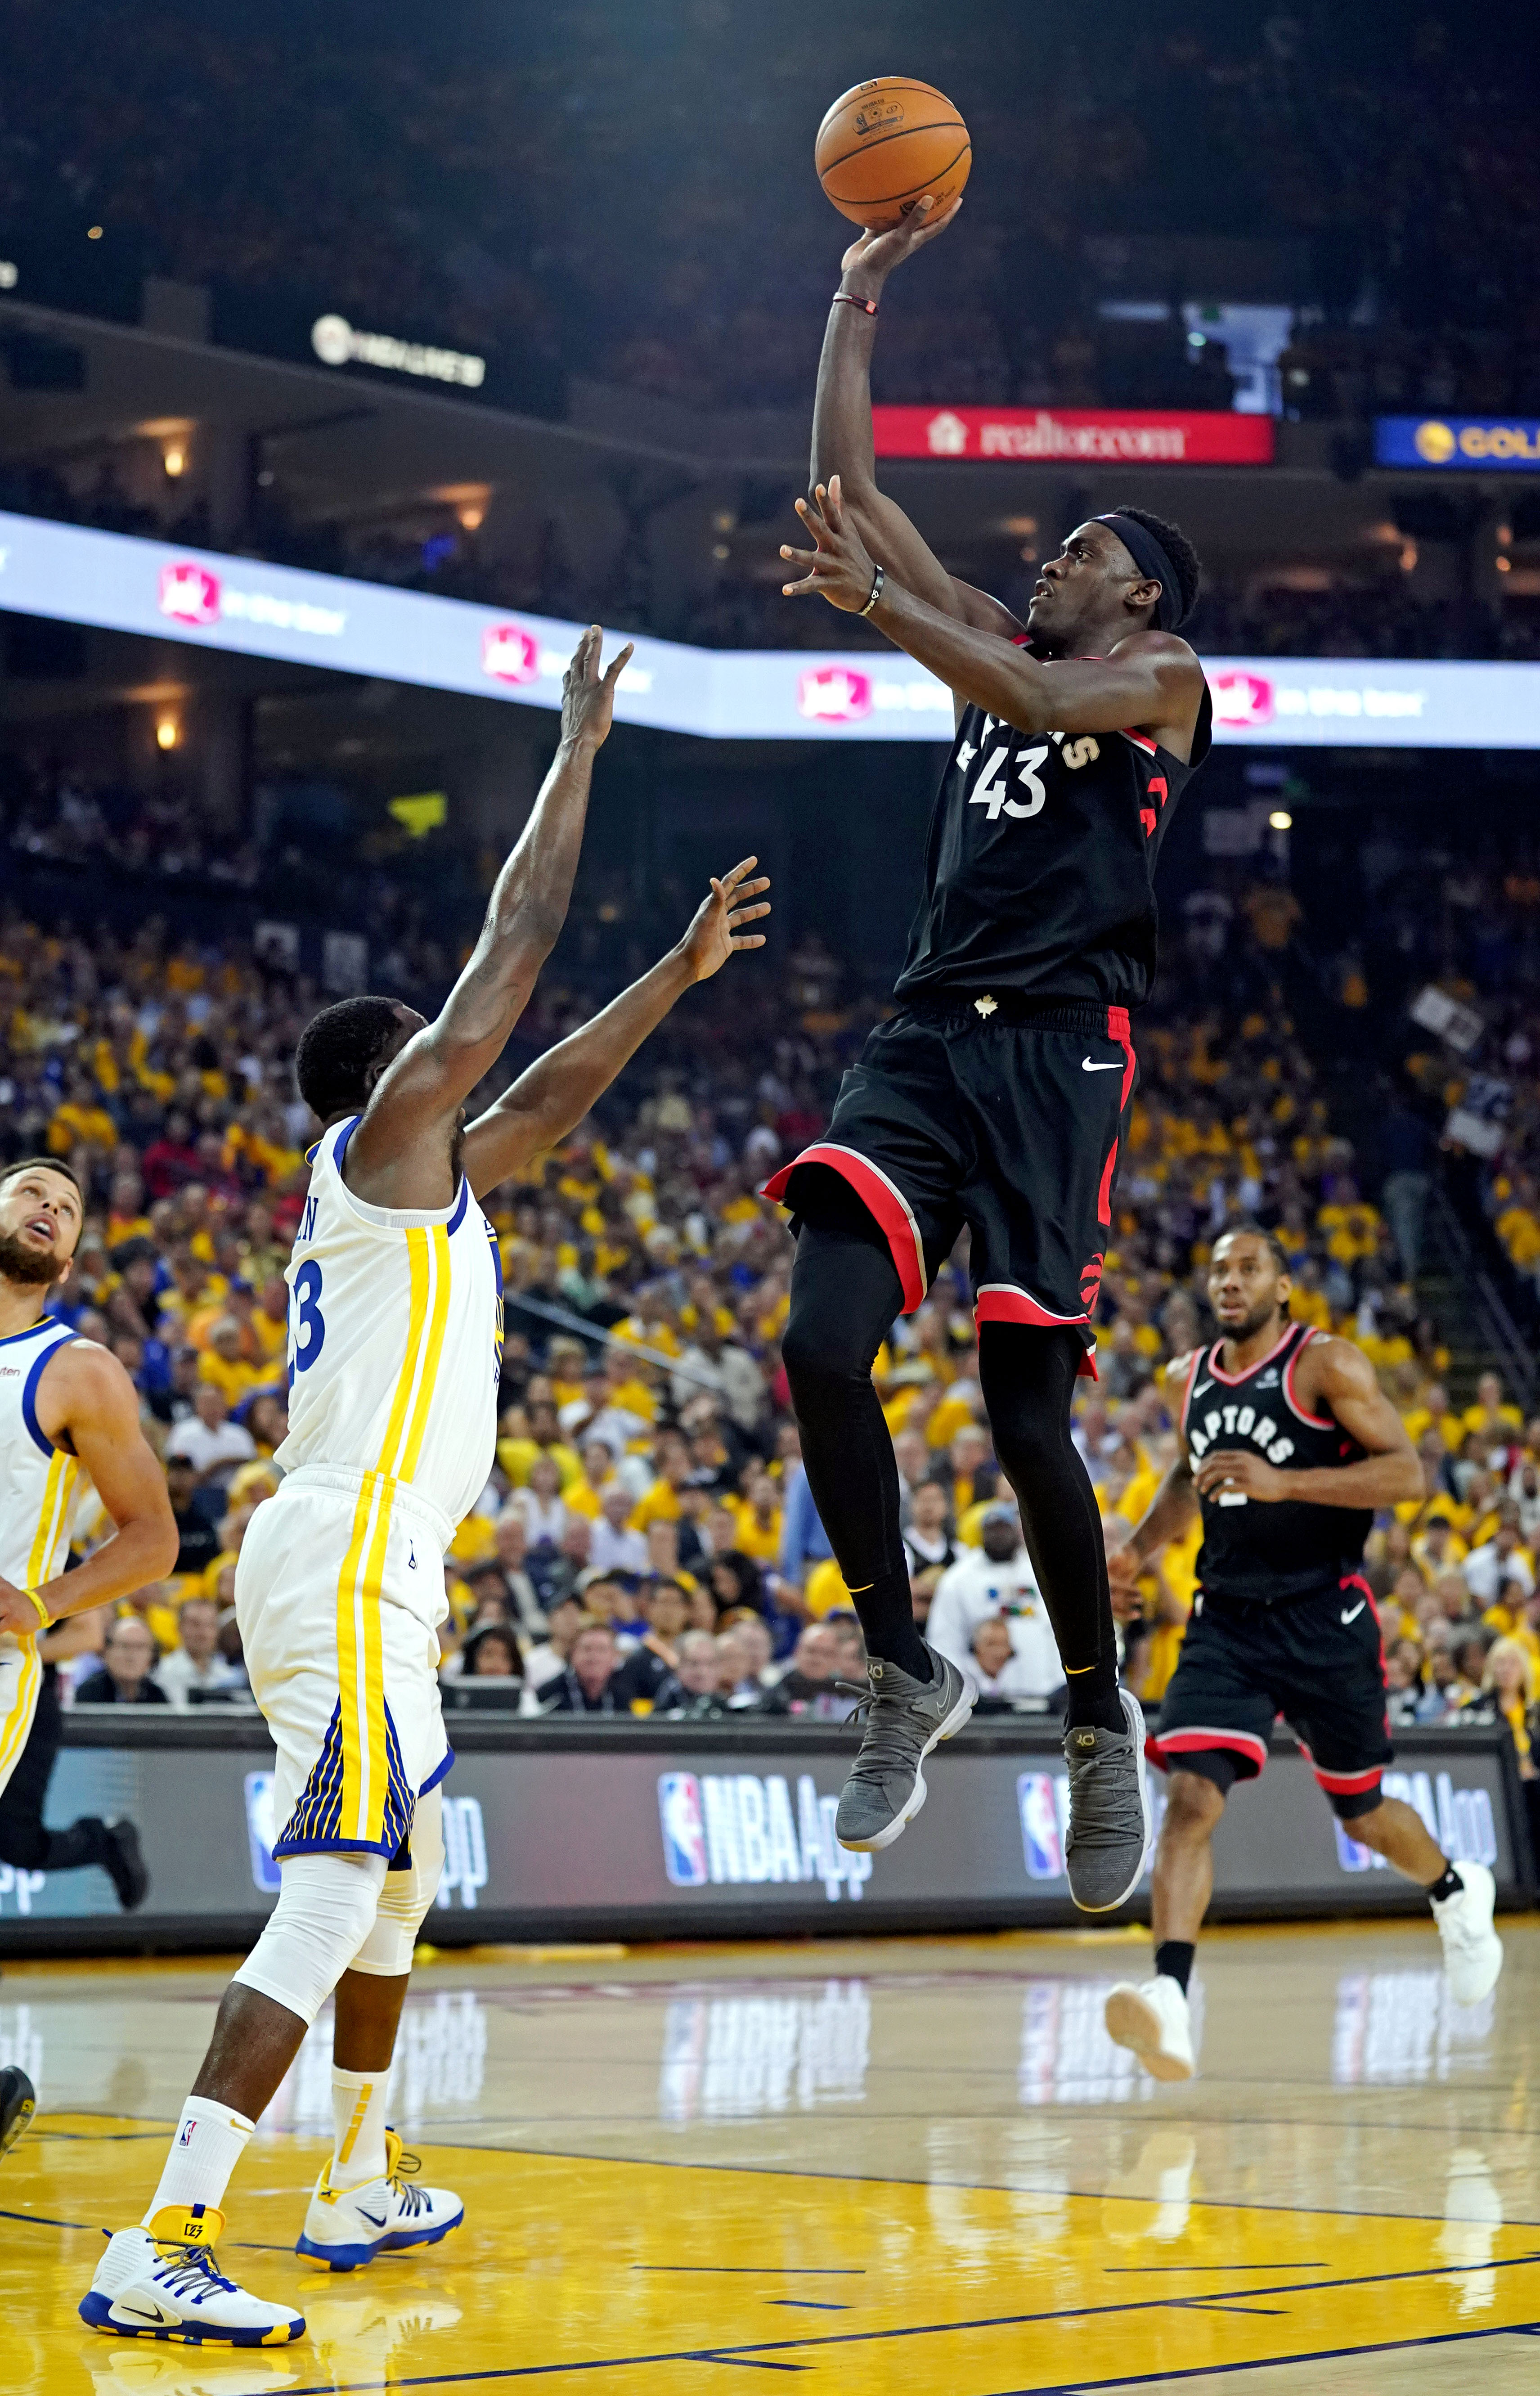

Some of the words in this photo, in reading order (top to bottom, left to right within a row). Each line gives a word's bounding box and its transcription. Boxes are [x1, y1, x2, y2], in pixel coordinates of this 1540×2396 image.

[1459, 426, 1540, 459] GOL
[969, 745, 1048, 819] 43
[436, 1796, 489, 1910] pp
[700, 1774, 801, 1884] NBA
